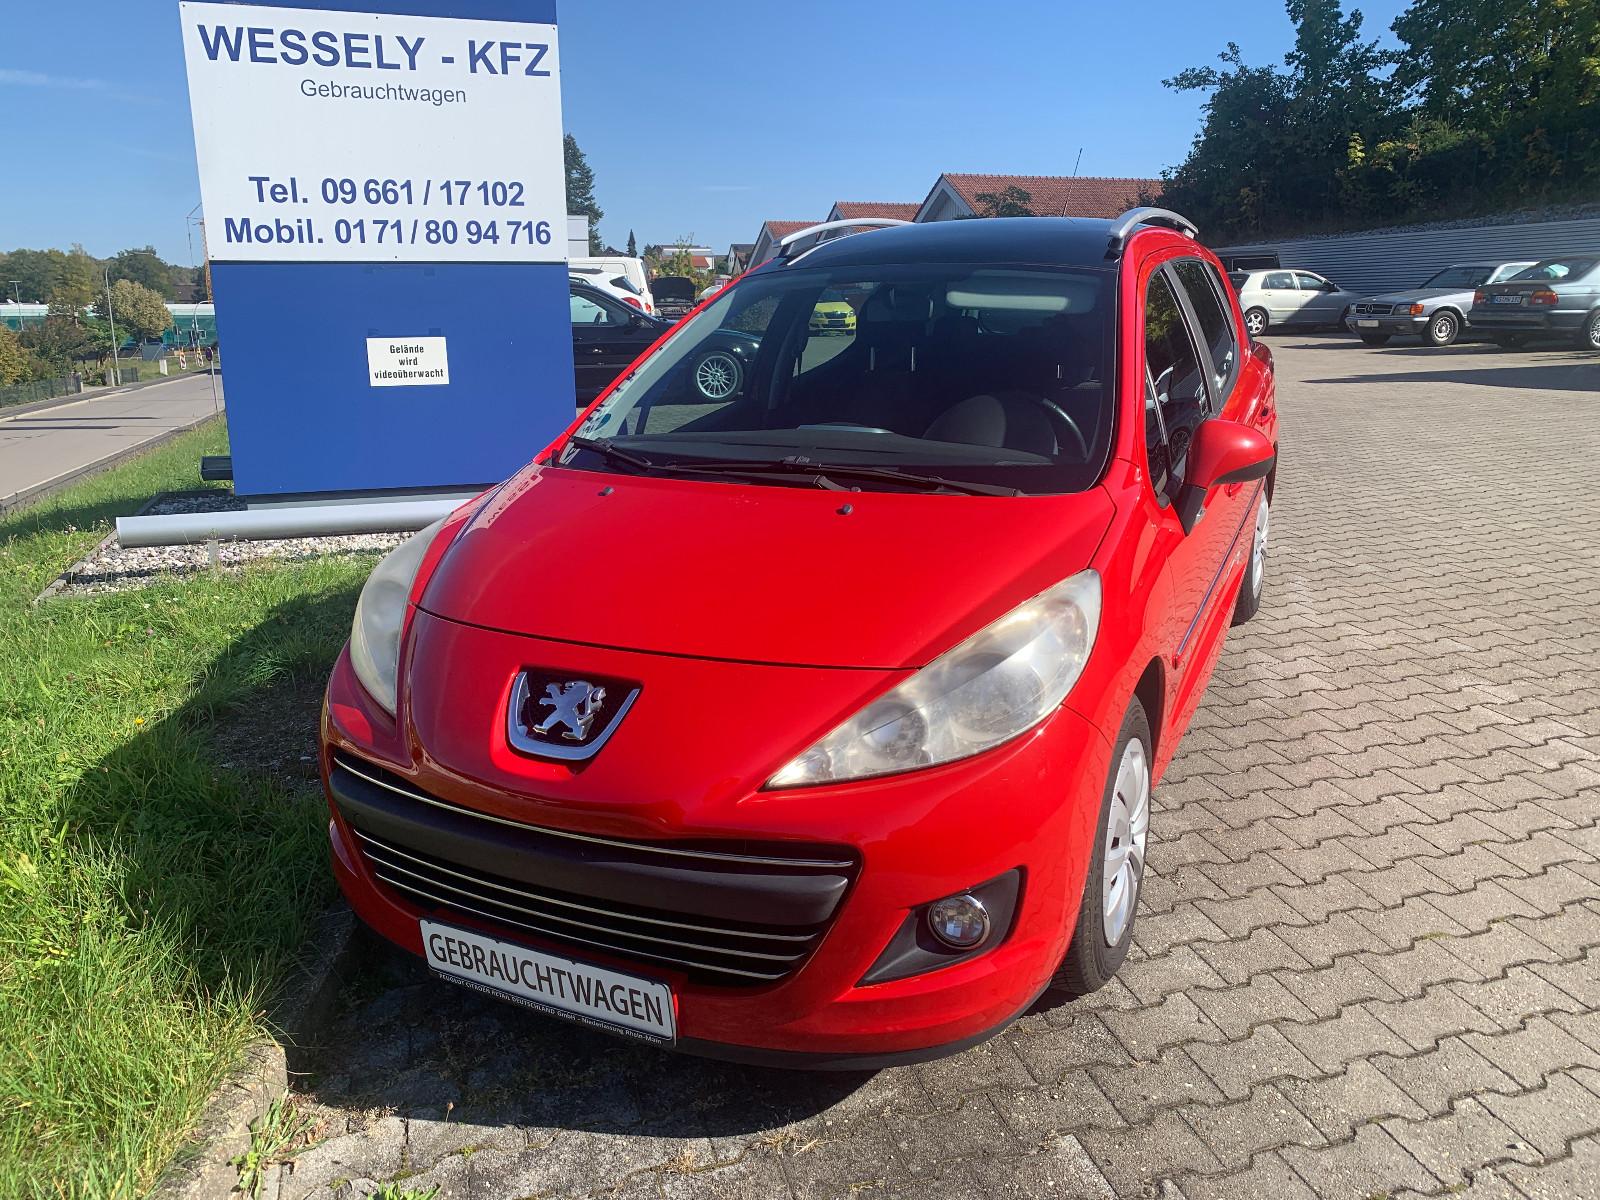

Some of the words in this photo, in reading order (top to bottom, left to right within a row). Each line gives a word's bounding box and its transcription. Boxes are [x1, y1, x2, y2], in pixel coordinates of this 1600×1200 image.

[197, 24, 425, 71] WESSELY
[468, 40, 551, 77] KFZ
[300, 79, 467, 106] Gebrauchtwagen
[248, 176, 308, 204] Tel.
[224, 217, 324, 244] Mobil.
[389, 344, 425, 354] Gelände
[398, 357, 418, 366] wird
[374, 368, 444, 379] videoüberwacht
[428, 932, 664, 1027] GEBRAUCHTWAGEN
